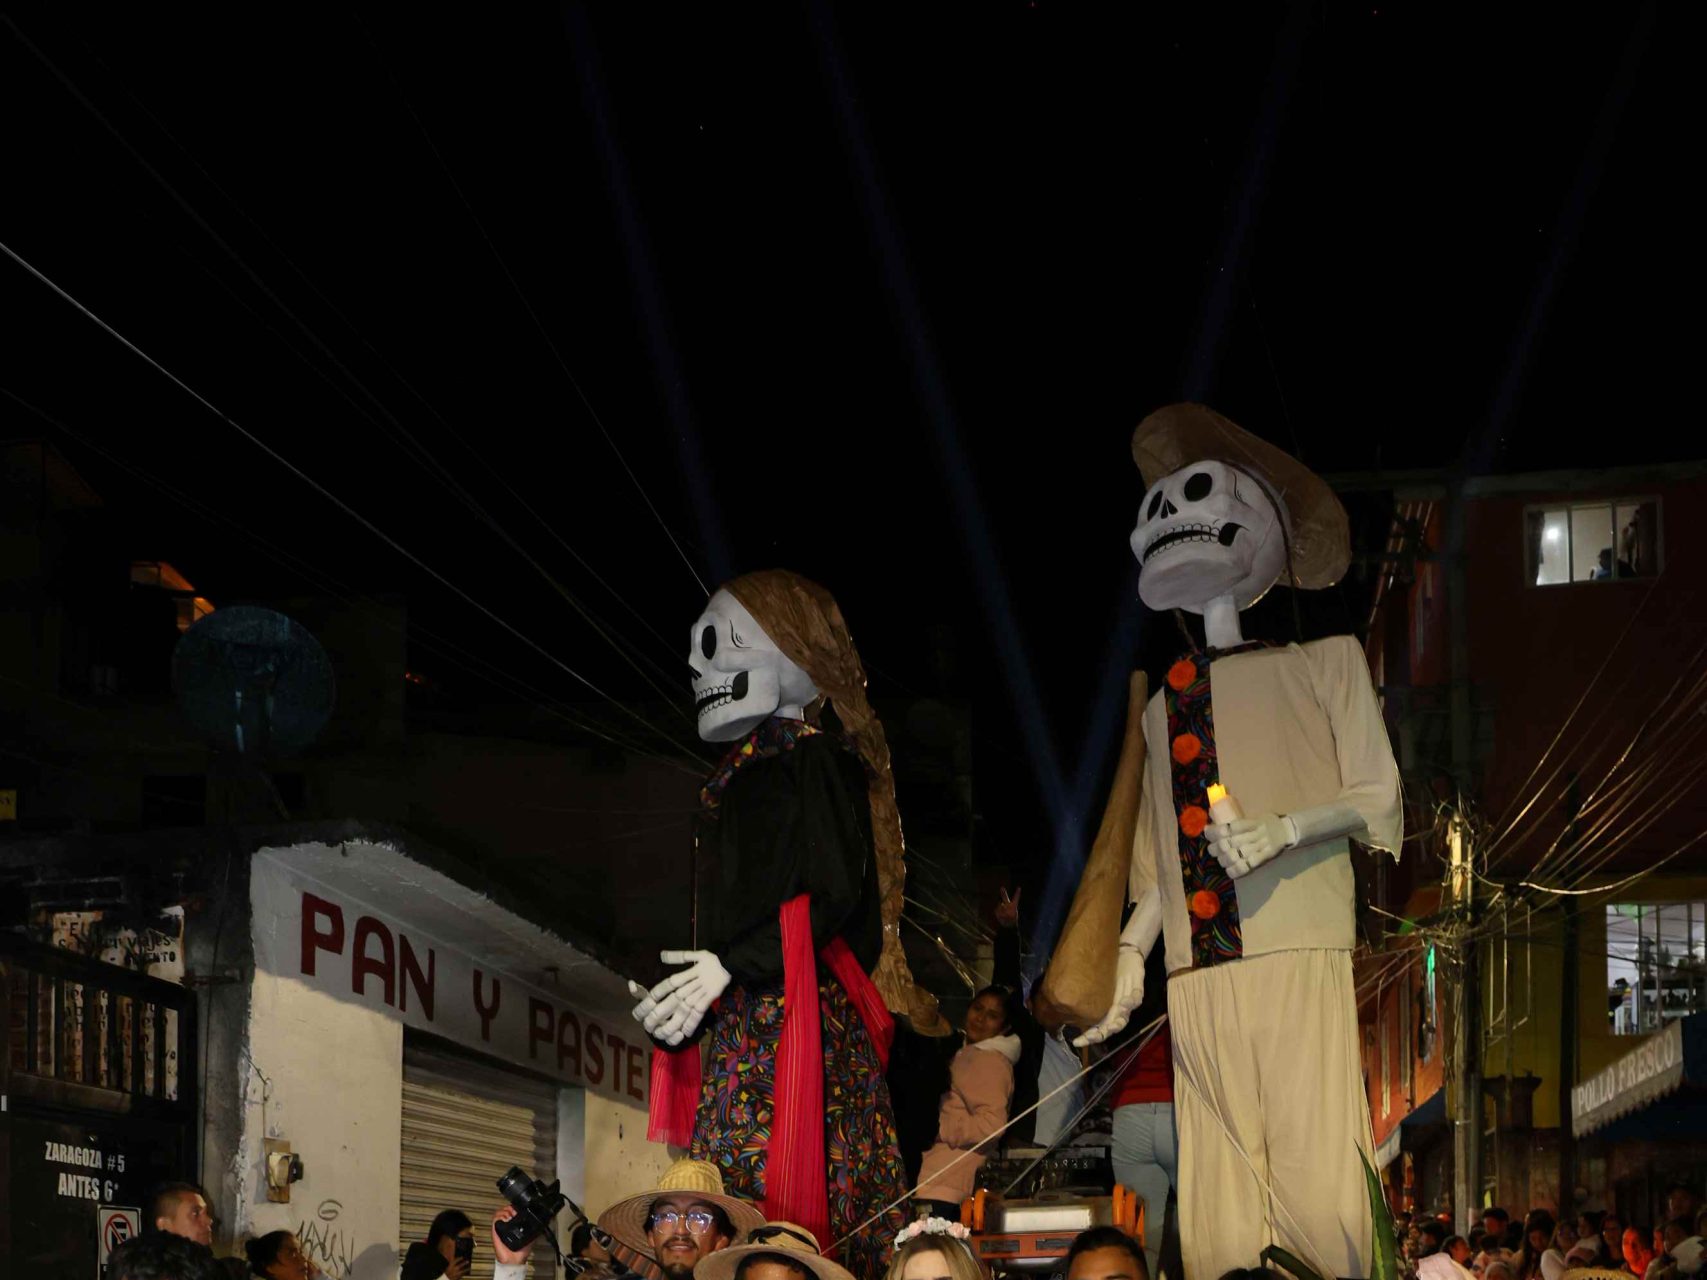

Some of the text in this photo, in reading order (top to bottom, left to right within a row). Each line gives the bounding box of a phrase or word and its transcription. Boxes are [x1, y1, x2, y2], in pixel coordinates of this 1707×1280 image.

[300, 891, 435, 1022] PAN
[472, 969, 500, 1042] Y
[1578, 1031, 1674, 1115] POLLO FRESCO
[45, 1141, 126, 1173] ZARAGOZA #5
[58, 1172, 100, 1200] ANTES
